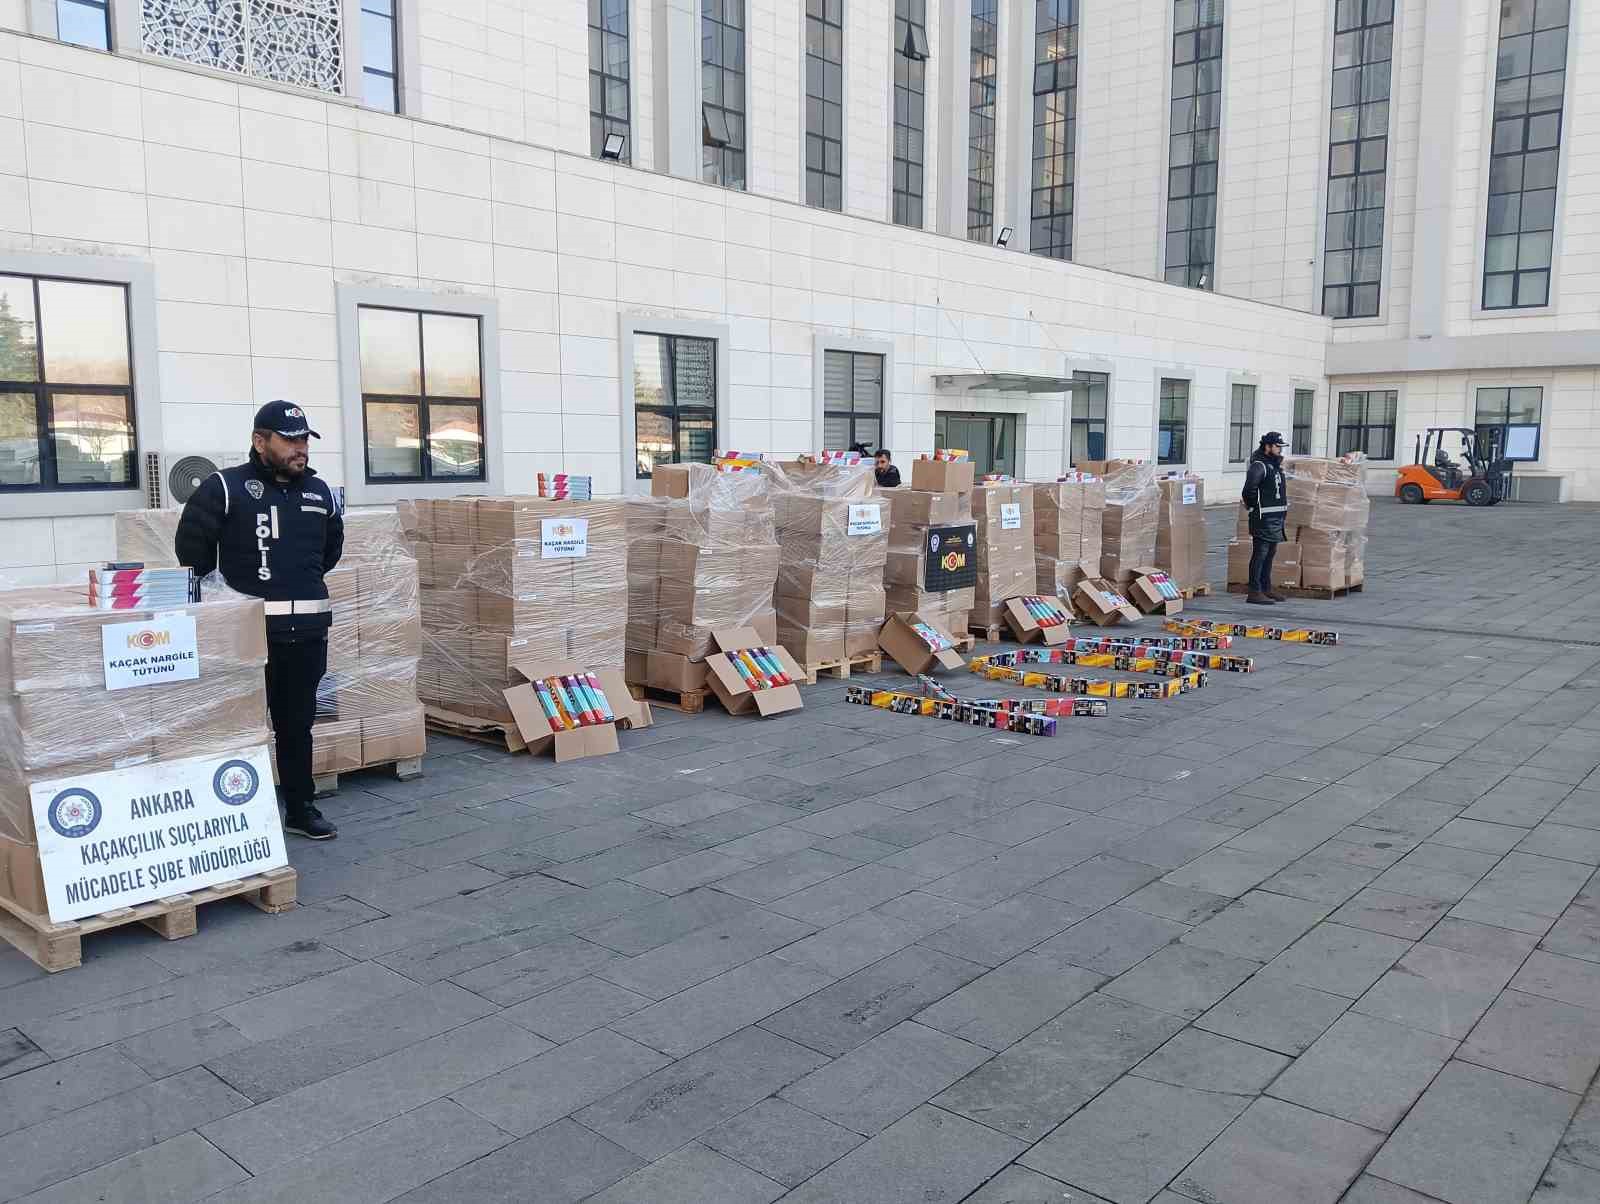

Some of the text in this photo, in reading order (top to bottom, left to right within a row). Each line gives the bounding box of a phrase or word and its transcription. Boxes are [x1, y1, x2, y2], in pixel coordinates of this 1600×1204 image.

[941, 552, 966, 571] KOM
[126, 629, 171, 650] KOM
[109, 650, 194, 669] KAÇAK NARGİLE
[132, 664, 175, 677] TÜTÜNÜ
[130, 788, 195, 820] ANKARA
[80, 812, 249, 866] KAÇAKÇILIK SUÇLARIYLA
[65, 836, 271, 905] MÜCADELE ŞUBE MÜDÜRLÜĞÜ
